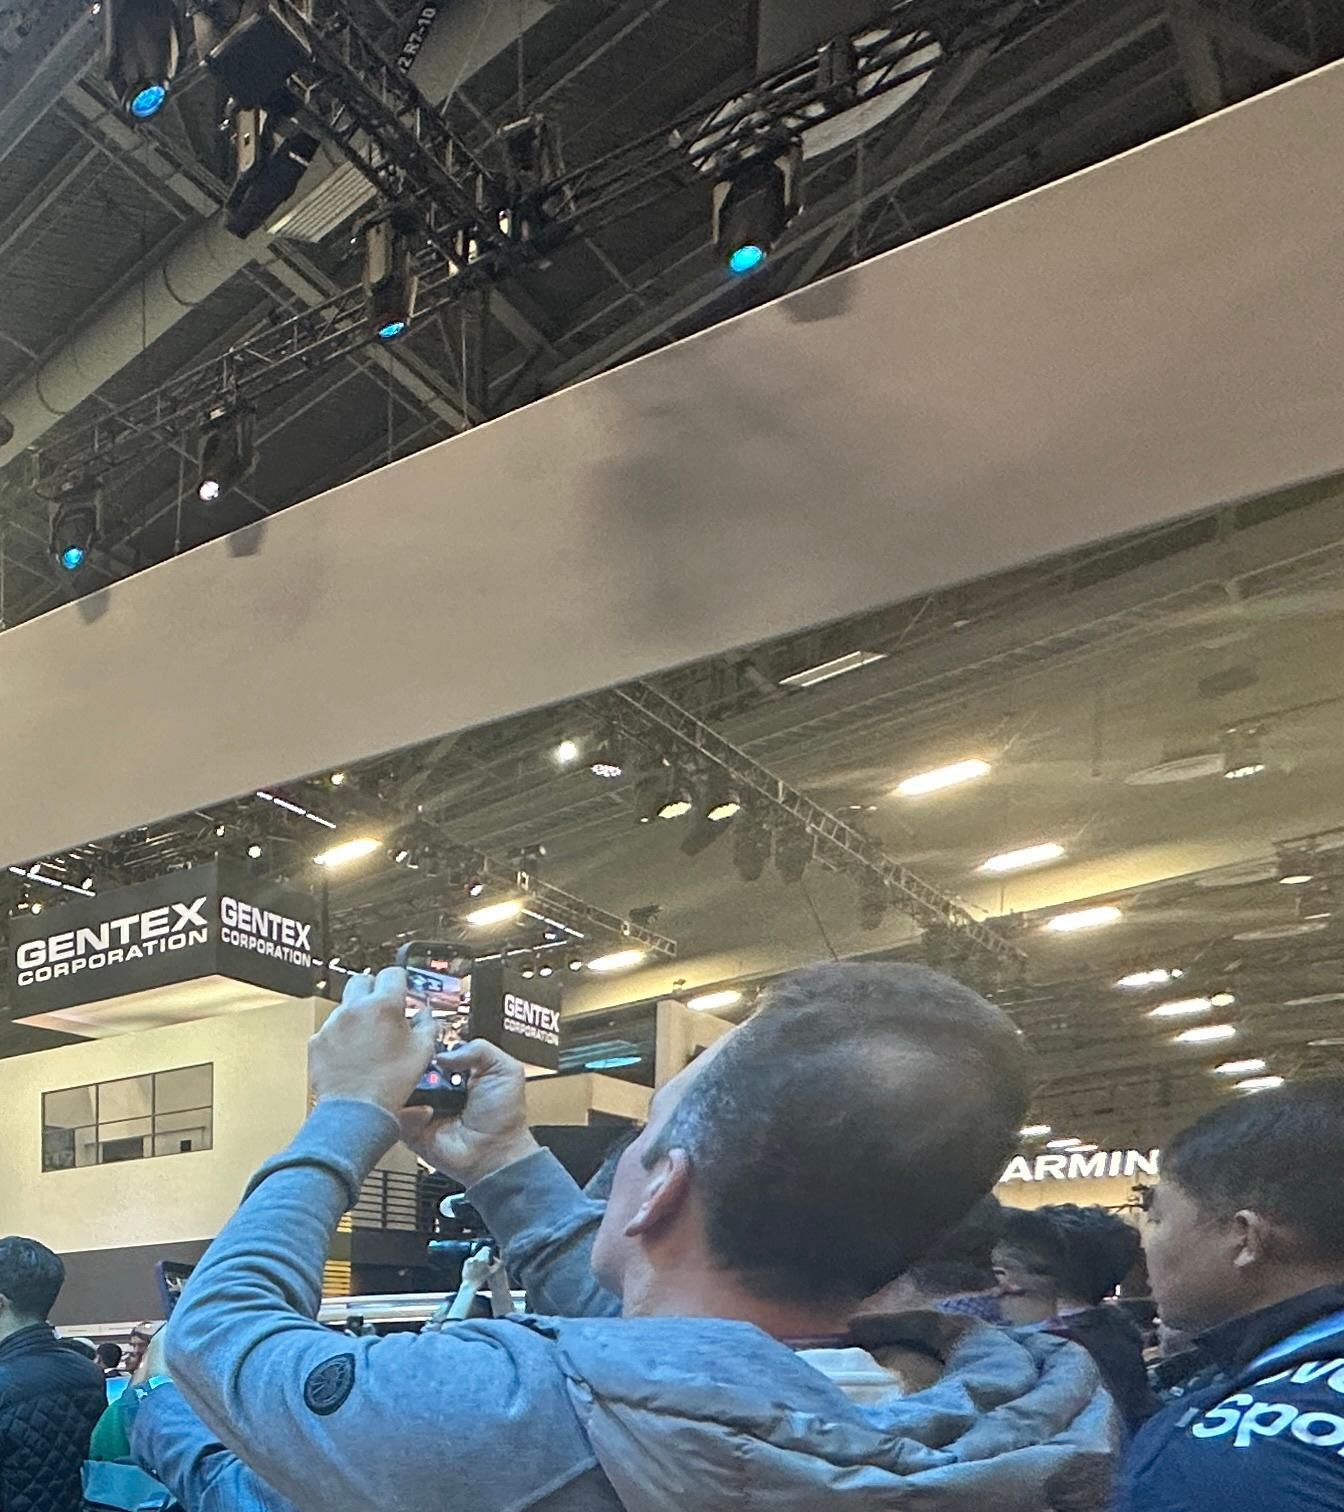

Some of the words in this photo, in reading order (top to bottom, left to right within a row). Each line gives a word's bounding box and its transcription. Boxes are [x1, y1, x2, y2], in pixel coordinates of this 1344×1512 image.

[16, 896, 208, 970] GENTEX
[220, 896, 311, 951] GENTEX
[221, 927, 311, 967] CORPORATION
[17, 928, 208, 986] CORPORATION
[505, 993, 559, 1033] GENTEX
[1192, 1393, 1344, 1458] Spo
